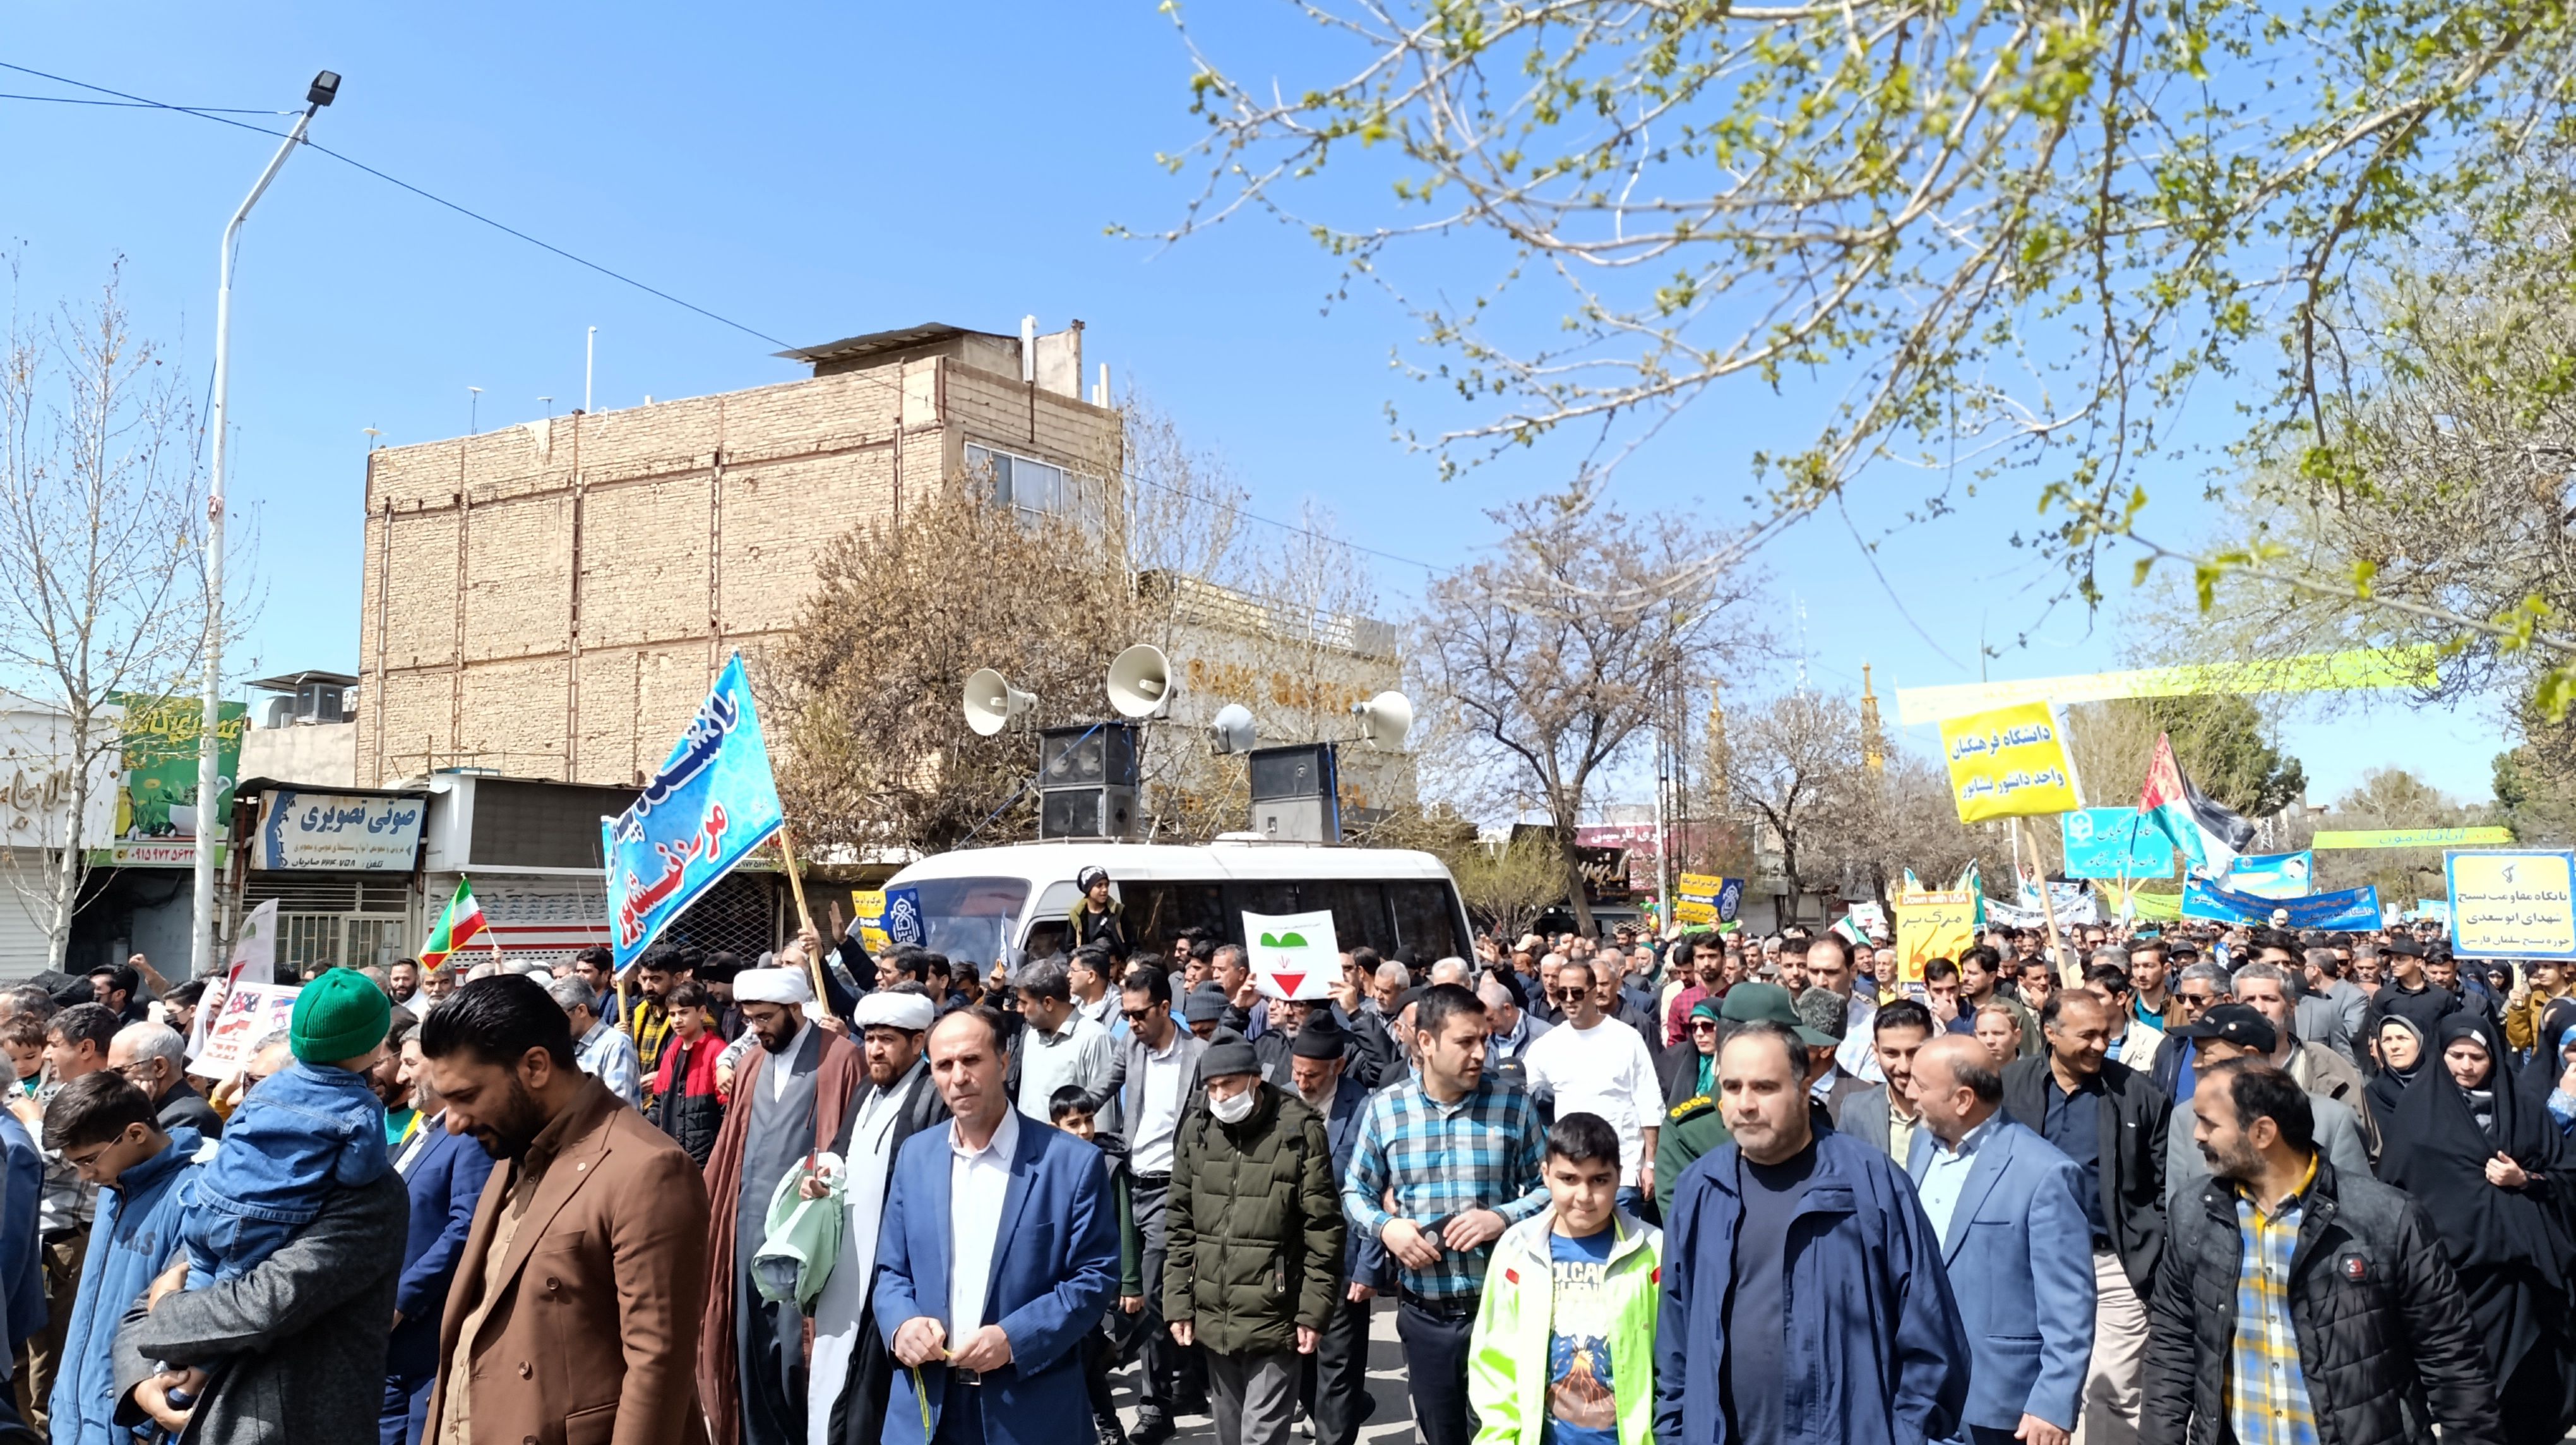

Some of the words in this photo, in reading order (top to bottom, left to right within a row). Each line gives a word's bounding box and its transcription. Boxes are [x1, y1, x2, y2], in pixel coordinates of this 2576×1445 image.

[2003, 724, 2051, 746] دانشگاه
[1952, 734, 2000, 760] فرهنگیان
[2034, 767, 2065, 786] واحد
[301, 800, 368, 833] تصویری
[368, 800, 416, 835] صوتی
[366, 860, 384, 869] تلفن
[621, 844, 685, 947] نیشابور
[1902, 895, 1928, 904] Down
[1928, 894, 1947, 904] with
[1949, 894, 1967, 903] USA
[2458, 892, 2486, 904] بسیج
[1902, 916, 1922, 928] بر
[1924, 909, 1962, 928] مرگ
[2521, 912, 2561, 926] شهدای
[2462, 935, 2491, 945] فارسی
[2493, 935, 2520, 945] سلمان
